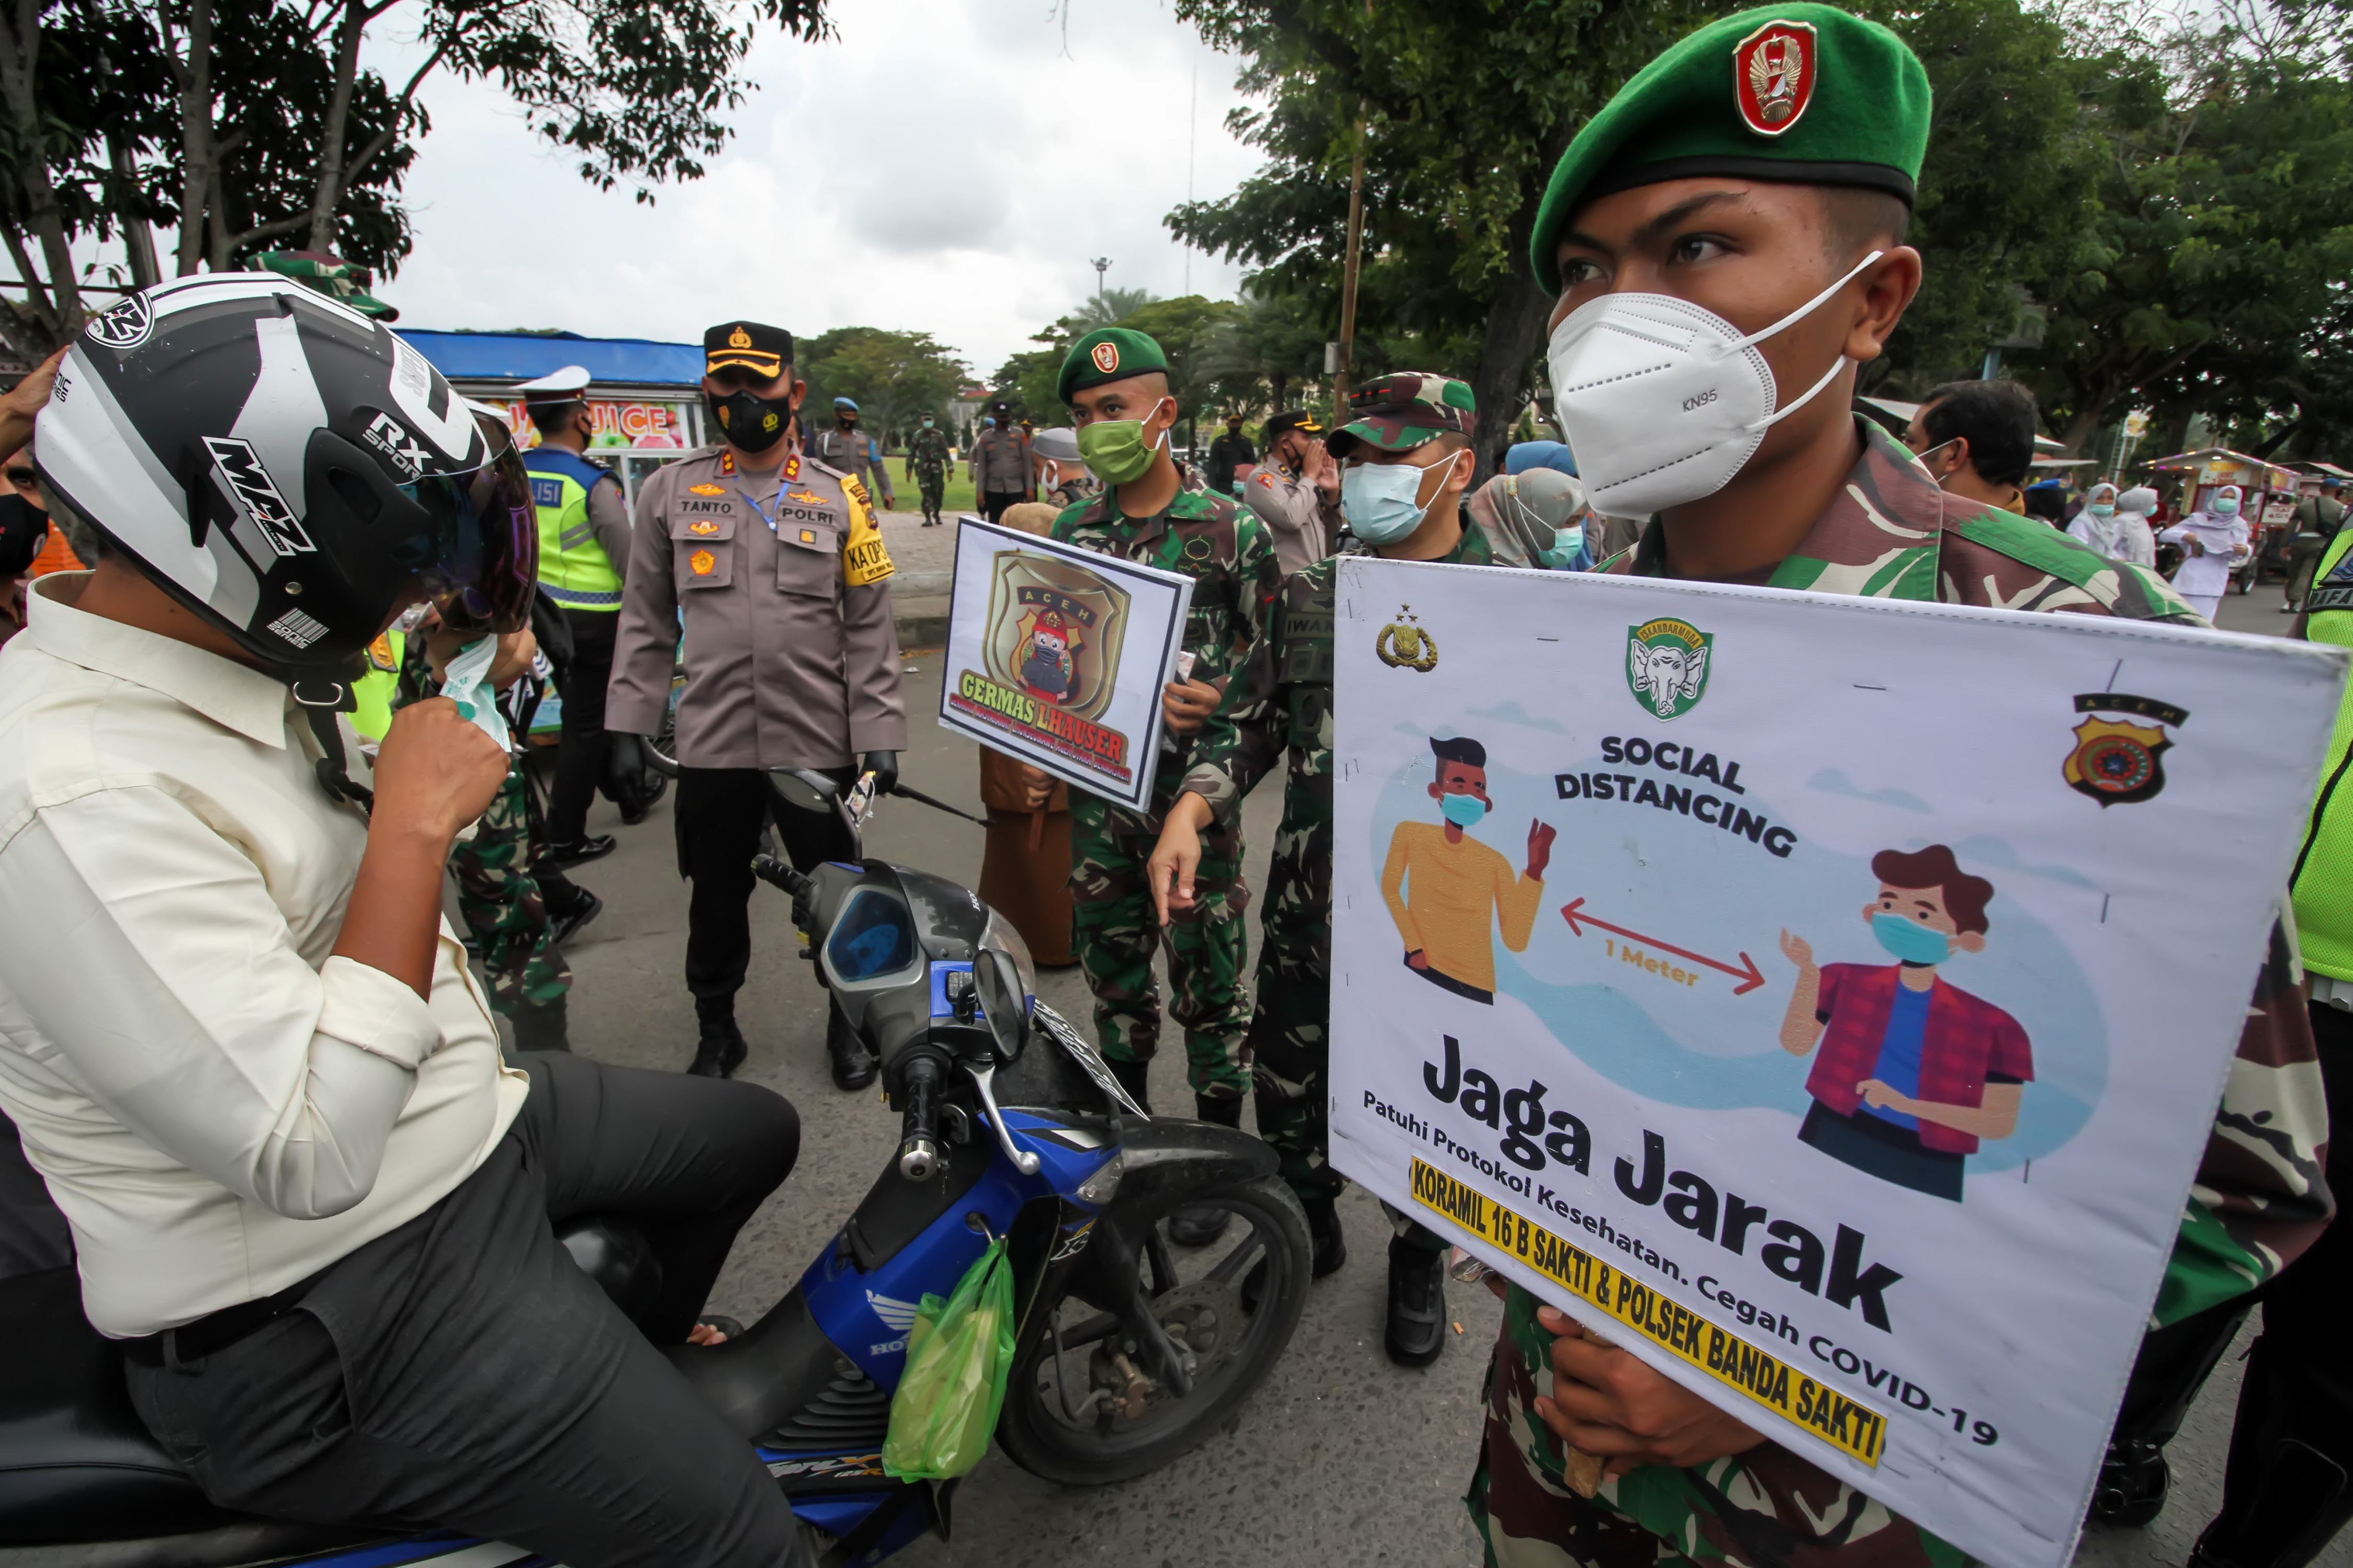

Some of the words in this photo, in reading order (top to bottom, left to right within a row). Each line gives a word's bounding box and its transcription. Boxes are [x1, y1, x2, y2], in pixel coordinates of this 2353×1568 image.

[1682, 389, 1717, 413] KN95
[203, 437, 316, 555] MAZ
[681, 501, 731, 514] TANTO
[782, 507, 833, 525] POLRI
[847, 547, 869, 571] KA
[867, 539, 887, 565] OPS
[1025, 591, 1089, 620] ACEH
[266, 622, 307, 649] SERIES
[274, 620, 312, 646] SONIC
[1640, 623, 1700, 647] ISKANDARMUDA
[961, 673, 1036, 726] GERMAS
[1036, 704, 1123, 764] LHAUSER
[2085, 699, 2176, 719] ACEH
[1600, 736, 1745, 795] SOCIAL
[1554, 772, 1798, 858] DISTANCING
[1605, 939, 1614, 957] 1
[1622, 945, 1699, 986] Meter
[1422, 1033, 1591, 1177] Jaga
[1613, 1129, 1905, 1334] Jarak
[1363, 1090, 1428, 1140] Patuhi
[1433, 1128, 1531, 1198] Protokol
[1537, 1184, 1689, 1286] Kesehatan.
[1696, 1275, 1799, 1345] Cegah
[1808, 1335, 1998, 1447] COVID-19
[1414, 1159, 1486, 1234] KORAMIL
[1492, 1205, 1512, 1247] 16
[1517, 1217, 1529, 1257] B
[1533, 1232, 1591, 1295] SAKTI
[1596, 1265, 1610, 1306] &
[1616, 1274, 1705, 1360] POLSEK
[1707, 1327, 1789, 1411] BANDA
[1796, 1378, 1881, 1459] SAKTI
